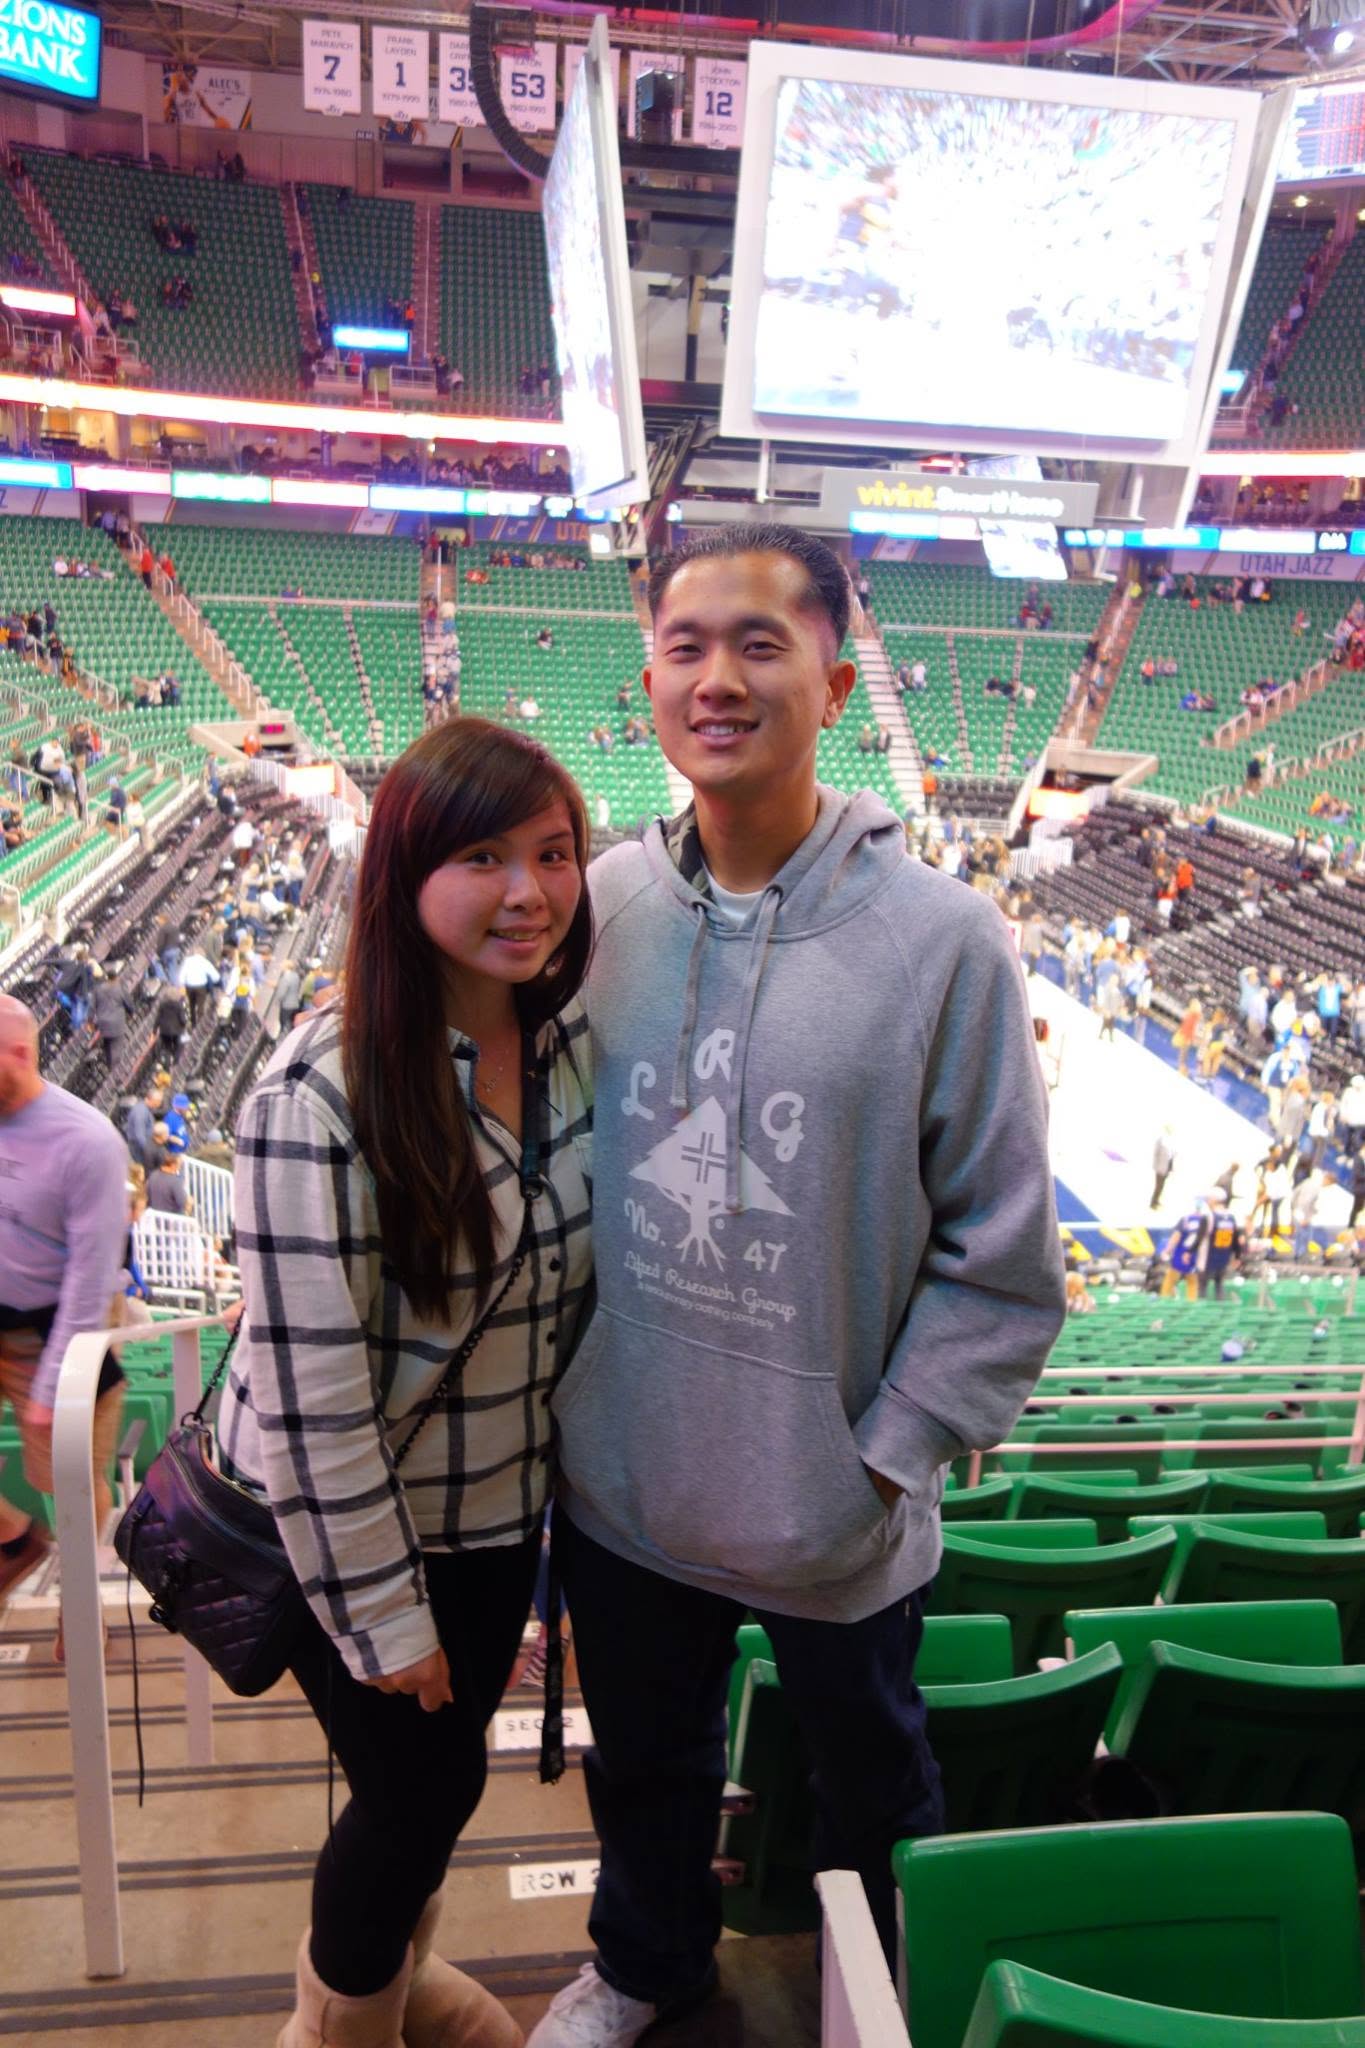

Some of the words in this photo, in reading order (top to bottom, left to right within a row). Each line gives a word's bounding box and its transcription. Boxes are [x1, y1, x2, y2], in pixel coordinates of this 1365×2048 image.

[0, 26, 88, 83] BANK
[323, 55, 341, 81] 7
[395, 62, 406, 87] 1
[511, 72, 545, 99] 53
[705, 92, 733, 117] 12
[556, 521, 589, 541] UTA
[1240, 554, 1286, 573] UTAH
[1289, 556, 1334, 575] JAZZ
[665, 1268, 736, 1303] Research
[742, 1287, 797, 1322] Group
[731, 1311, 775, 1331] company
[521, 1869, 576, 1892] ROW
